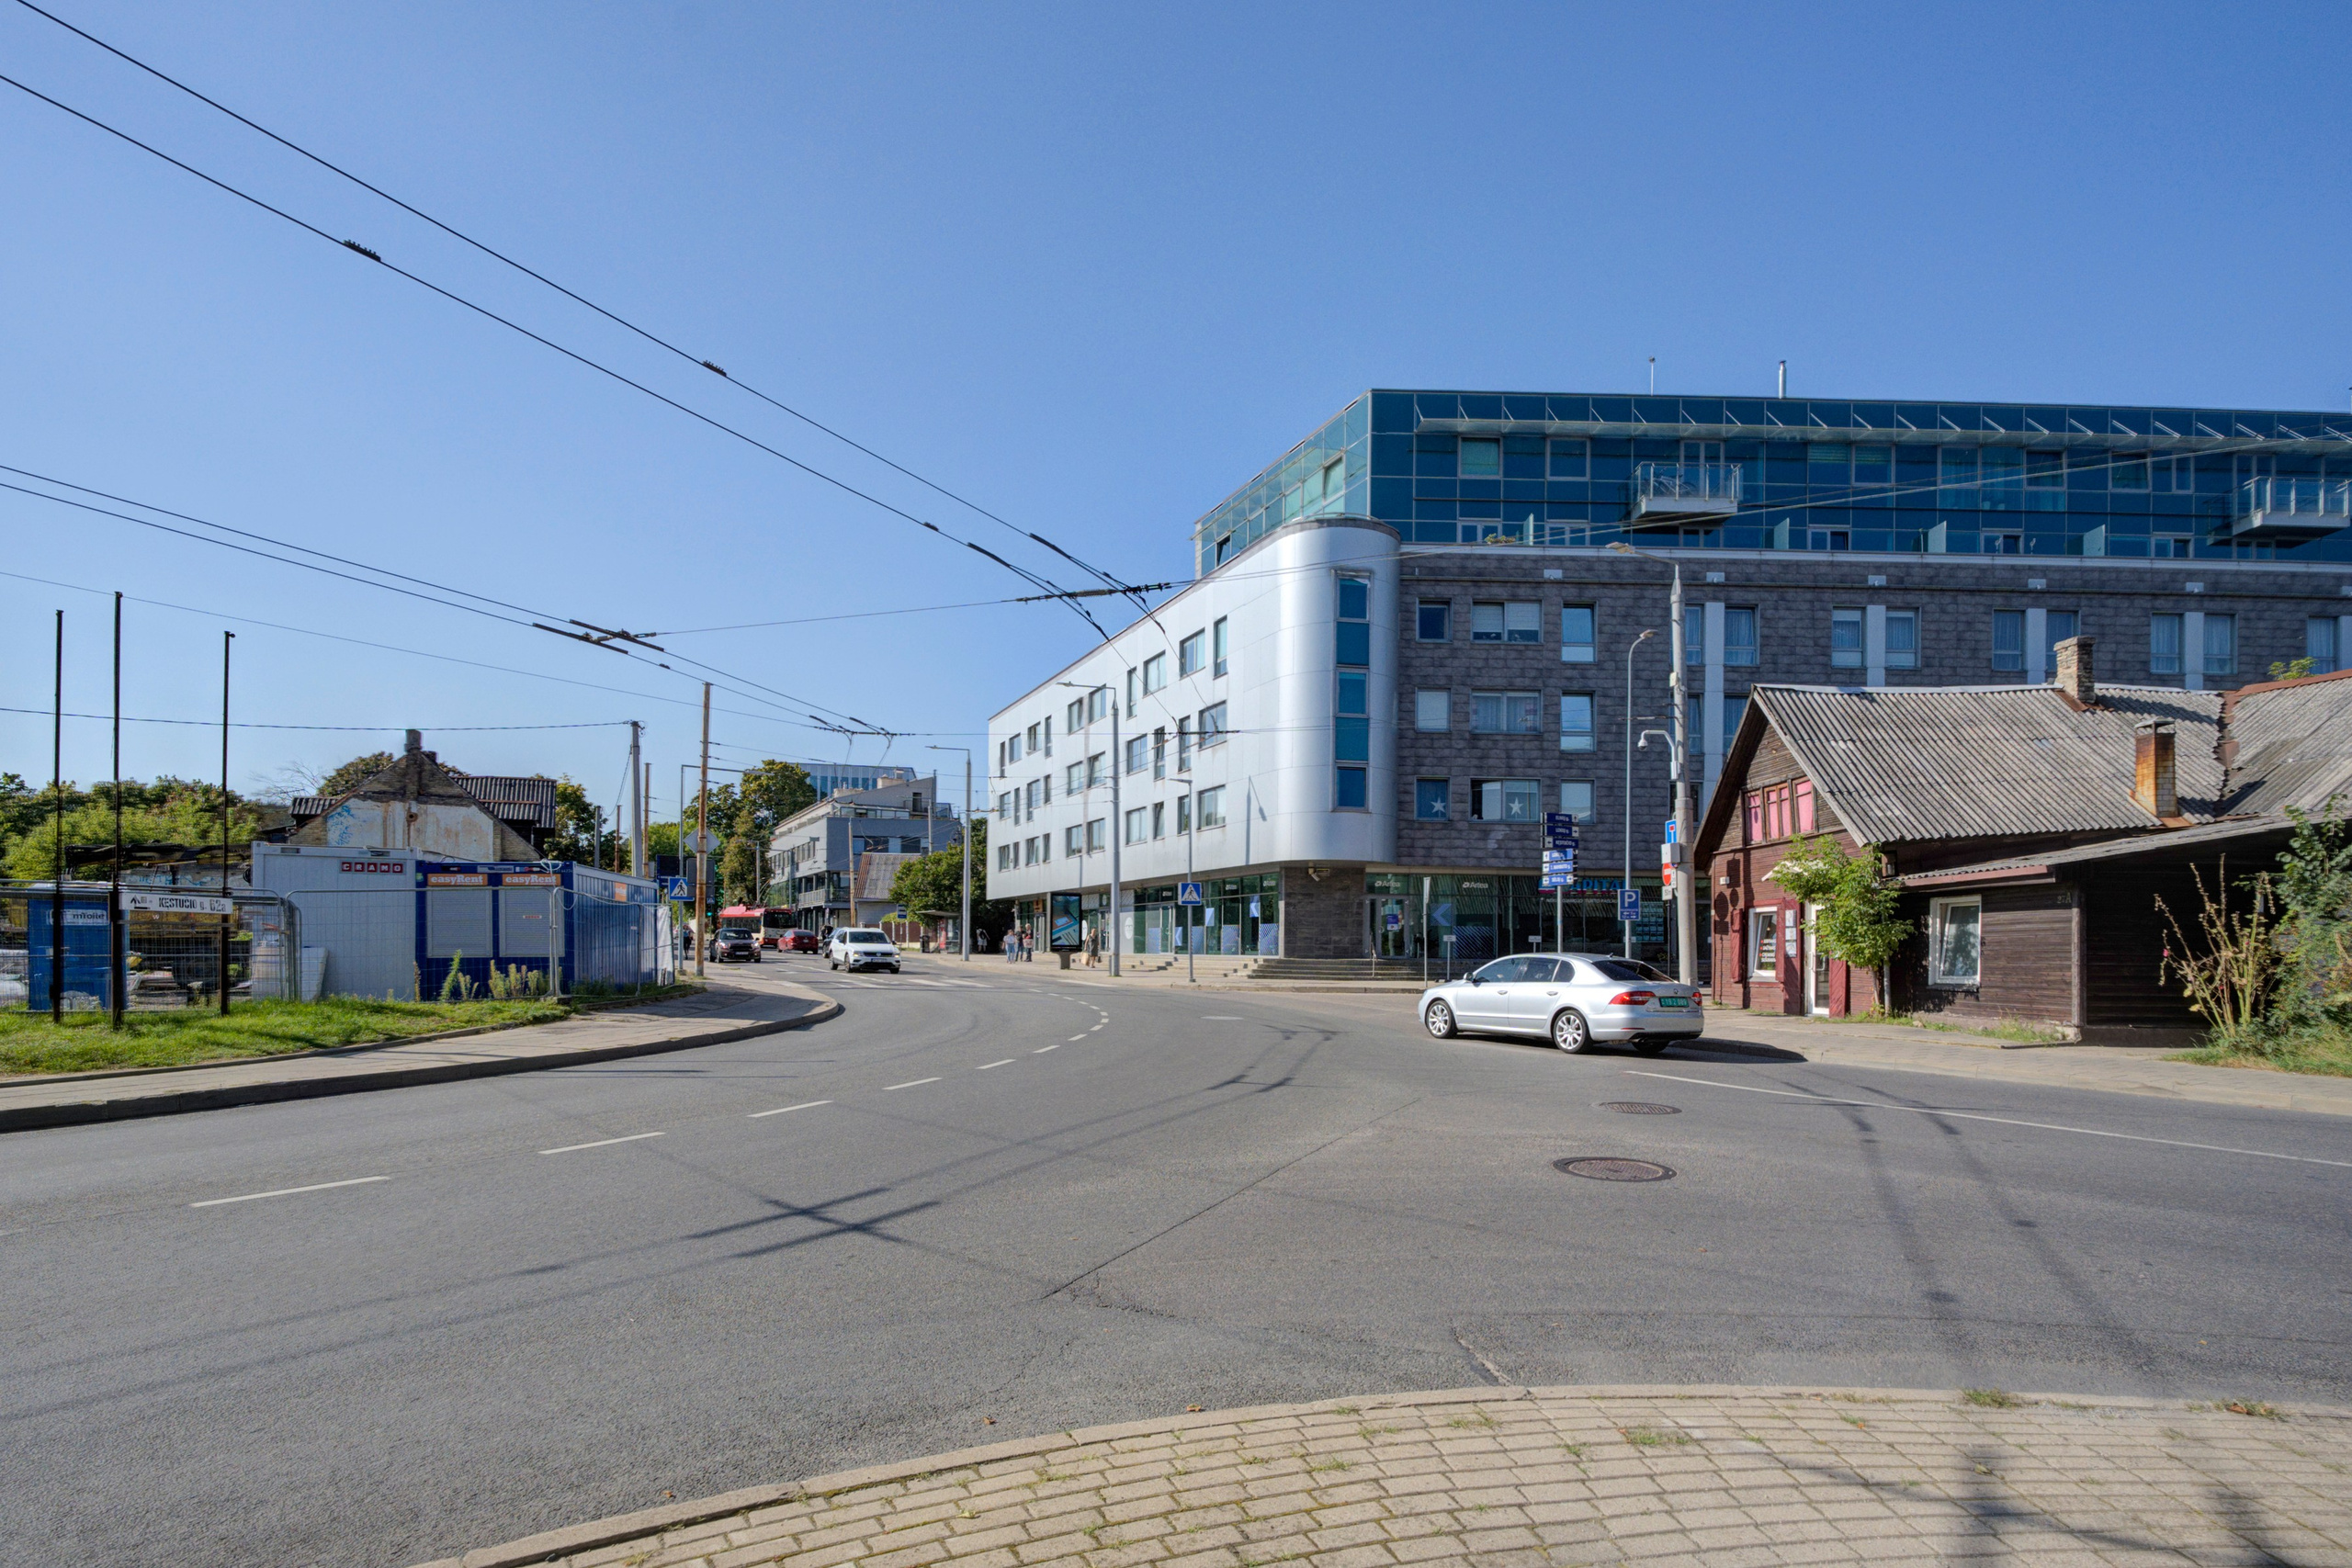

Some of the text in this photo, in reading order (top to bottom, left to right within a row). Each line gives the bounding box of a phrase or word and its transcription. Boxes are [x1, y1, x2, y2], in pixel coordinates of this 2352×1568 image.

[342, 863, 403, 873] CRAMO
[431, 874, 483, 886] easyRent
[505, 874, 557, 886] easyRent
[159, 896, 227, 912] KĘSTUČIO g. 62a
[1624, 892, 1636, 908] P
